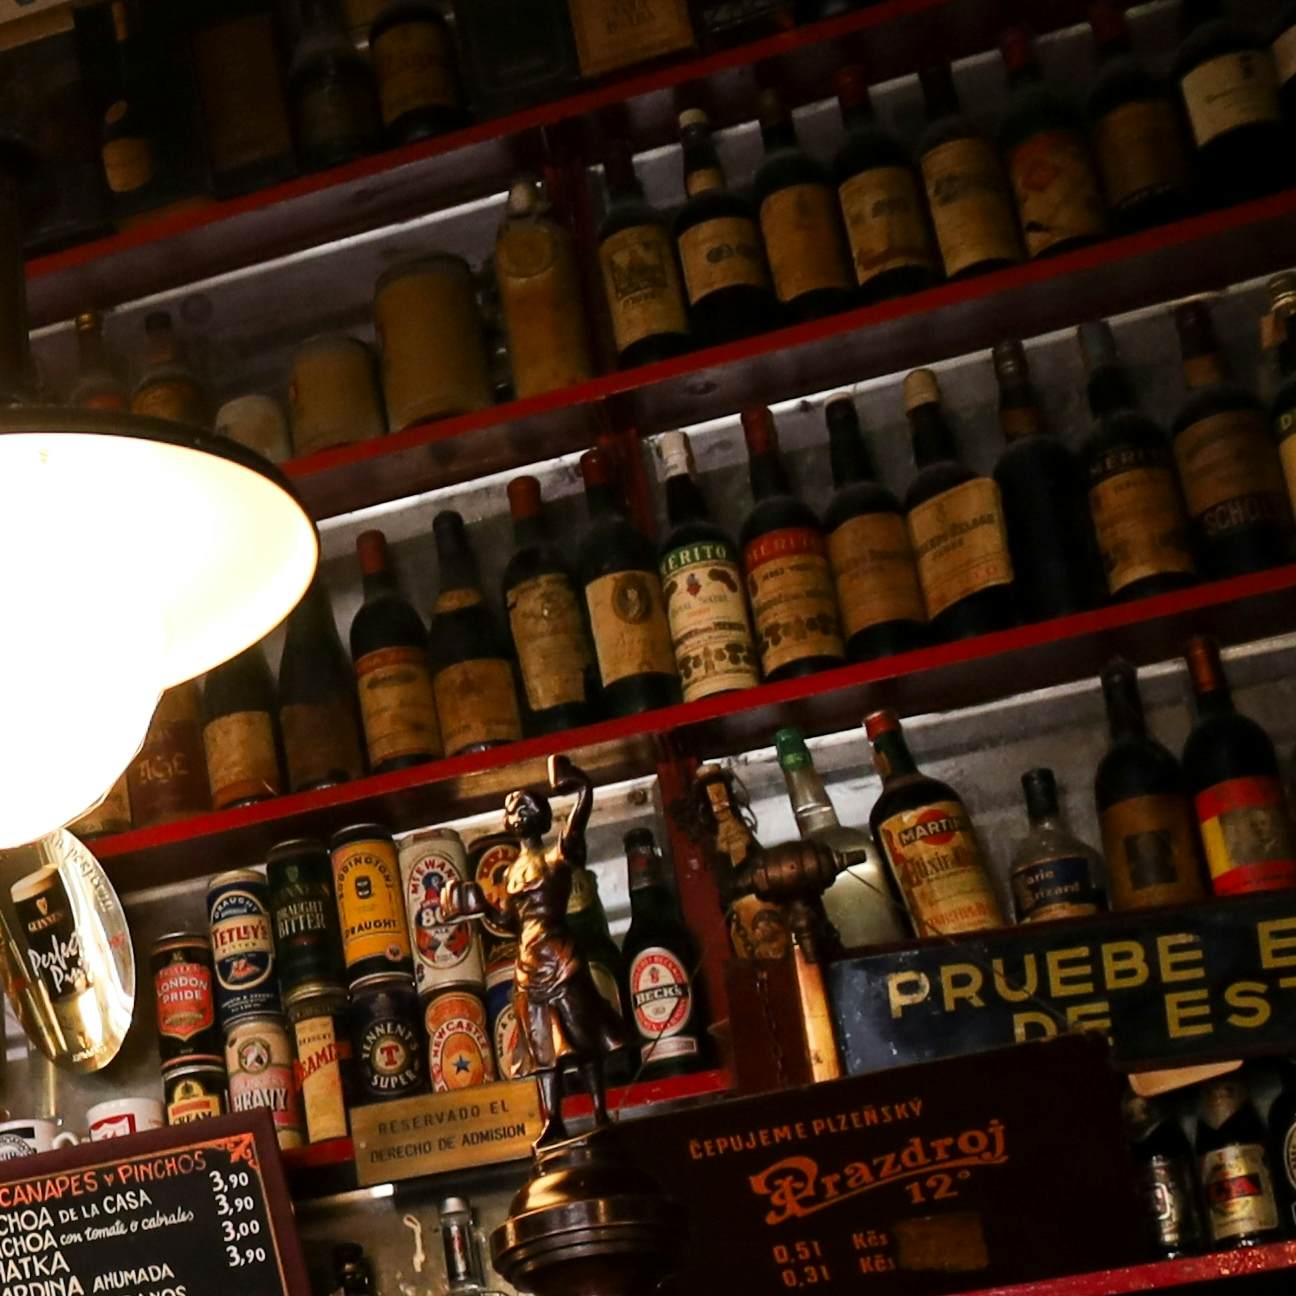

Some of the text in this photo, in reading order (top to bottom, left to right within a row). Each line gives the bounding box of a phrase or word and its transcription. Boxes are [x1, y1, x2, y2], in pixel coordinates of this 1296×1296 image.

[886, 931, 1206, 1019] PRUEBE
[377, 1101, 509, 1137] RESERVADO EL
[370, 1122, 527, 1163] DERECHO DE ADMISION
[116, 1149, 206, 1185] PINCHOS
[748, 1116, 1010, 1226] Prazdroj
[58, 1207, 79, 1224] DE
[81, 1203, 100, 1219] LA
[102, 1189, 153, 1214] CASA
[209, 1170, 249, 1193] 3,90
[221, 1219, 260, 1242] 3,00
[92, 1263, 175, 1293] AHUMADA
[226, 1245, 266, 1267] 3,90
